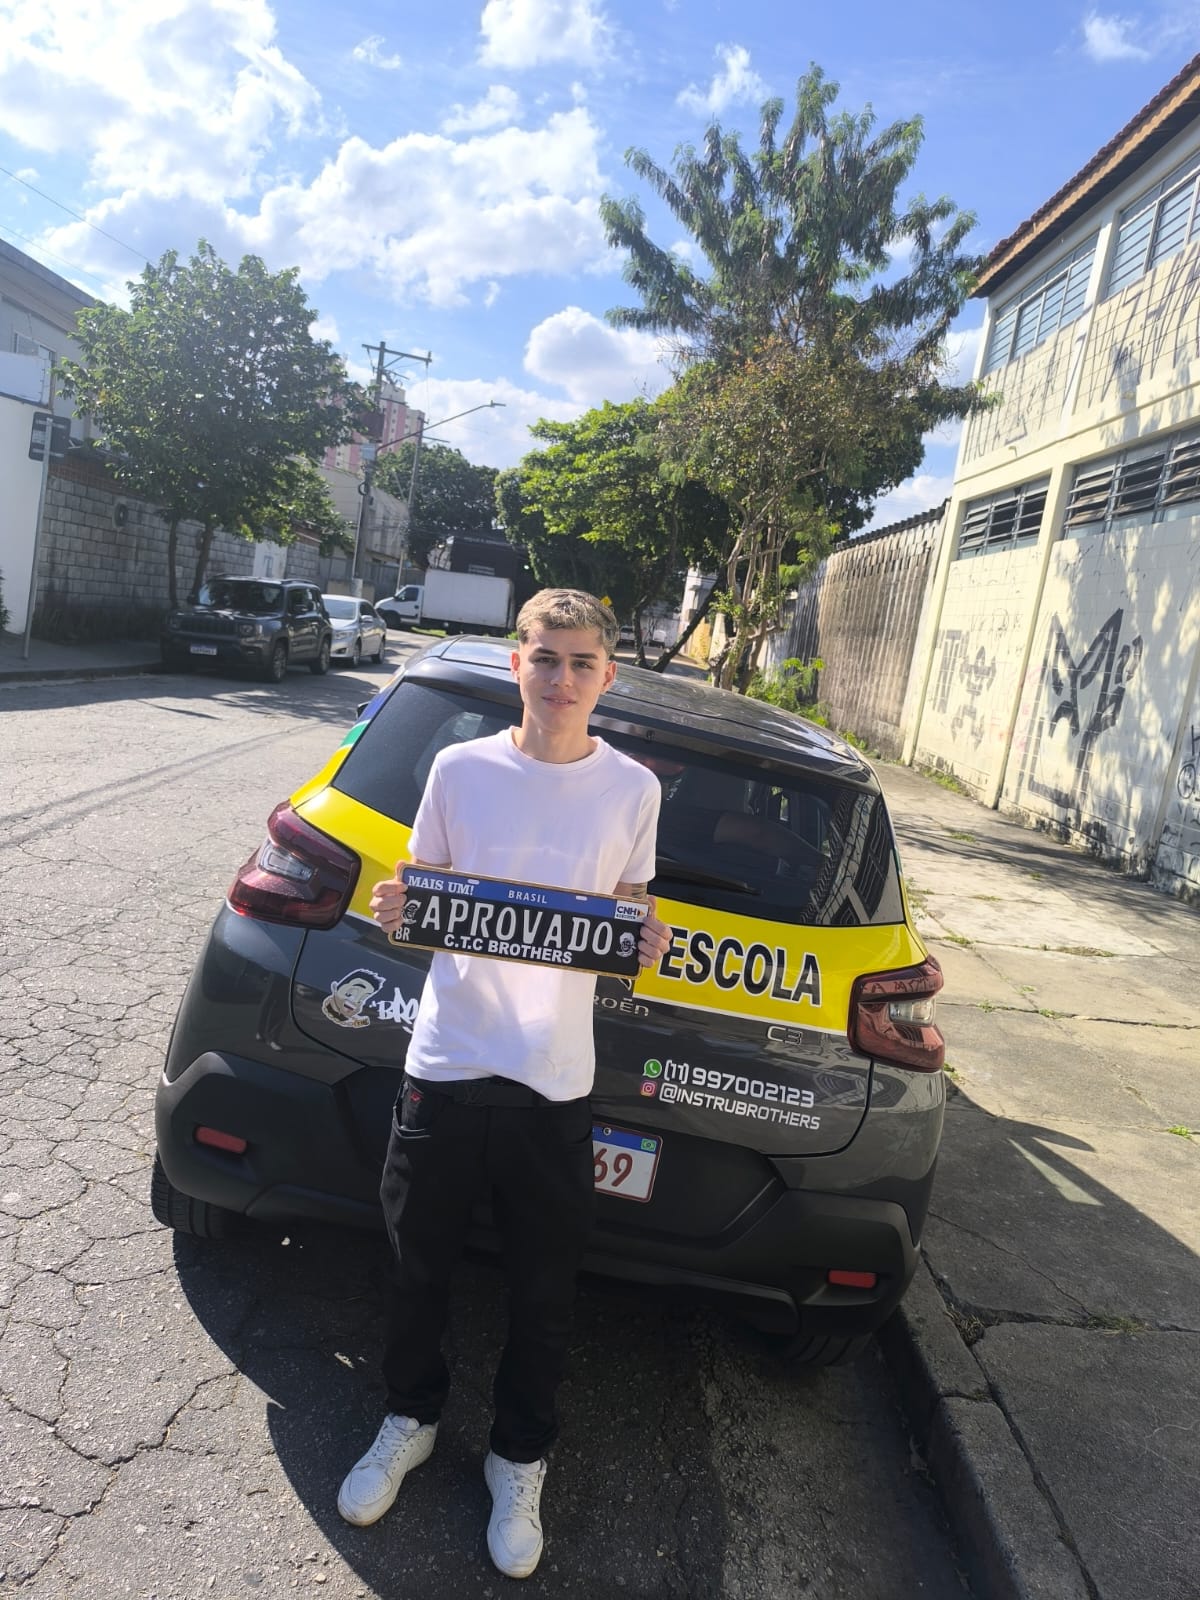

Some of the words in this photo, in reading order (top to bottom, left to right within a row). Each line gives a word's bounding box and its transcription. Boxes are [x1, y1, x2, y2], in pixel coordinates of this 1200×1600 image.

[408, 875, 443, 891] MAIS
[448, 881, 474, 896] UM!
[508, 890, 548, 904] BRASIL
[421, 895, 613, 956] APROVADO
[617, 905, 637, 916] CNH
[395, 927, 410, 941] BR
[444, 933, 483, 951] C.T.C
[488, 940, 572, 964] BROTHERS
[658, 926, 821, 1007] ESCOLA
[767, 1025, 803, 1046] C3
[664, 1059, 690, 1085] (11)
[692, 1067, 815, 1109] 997002123
[659, 1082, 821, 1130] @INSTRUBROTHERS
[593, 1147, 633, 1187] 69
